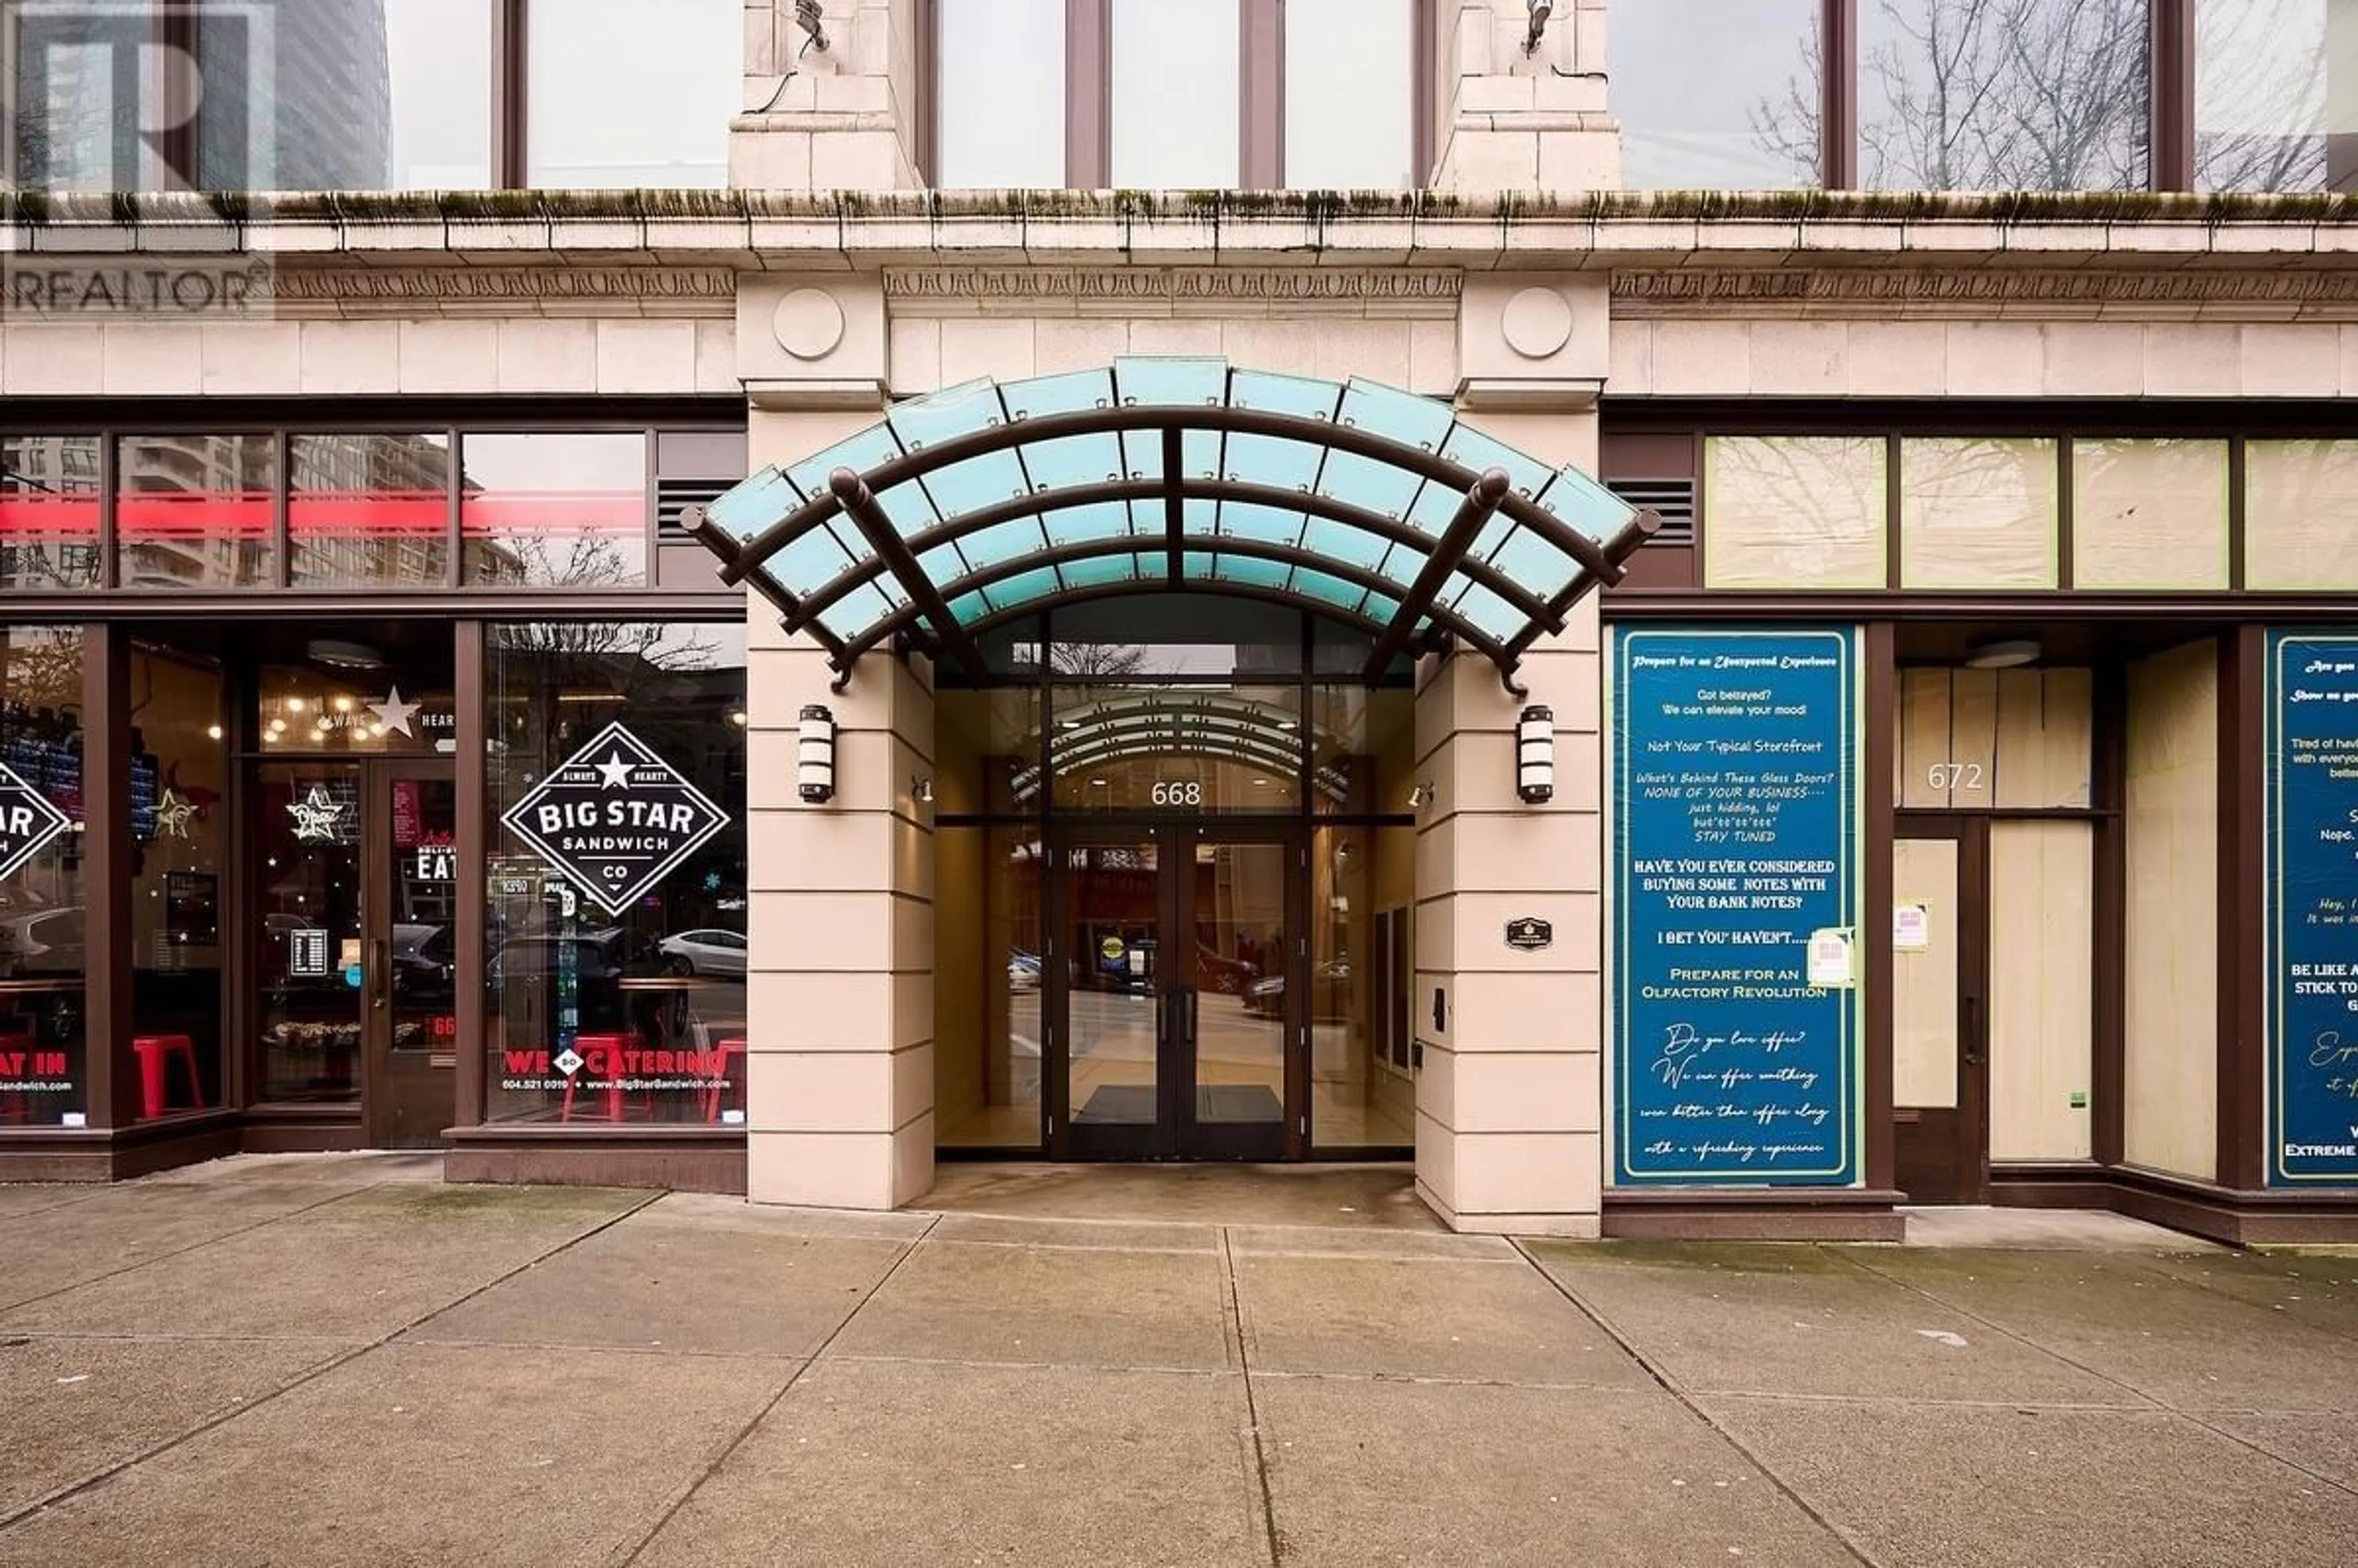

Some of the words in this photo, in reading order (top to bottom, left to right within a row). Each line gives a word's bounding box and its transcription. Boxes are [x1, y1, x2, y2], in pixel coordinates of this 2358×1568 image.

[1680, 656, 1696, 667] for
[1697, 689, 1718, 701] Got
[1720, 689, 1772, 703] betrayed?
[1662, 705, 1679, 715] We
[1683, 707, 1703, 715] can
[1706, 705, 1744, 715] elevate
[1747, 707, 1771, 718] your
[1648, 740, 1672, 752] Not
[1675, 740, 1702, 752] Your
[1706, 740, 1751, 755] Typical
[1754, 739, 1824, 753] Storefront
[2291, 739, 2319, 749] Tired
[563, 772, 596, 781] ALWAYS
[634, 772, 667, 781] HEARTY
[1636, 772, 1675, 783] What's
[1679, 772, 1718, 783] Behind
[1724, 772, 1756, 783] These
[1761, 772, 1789, 783] Glass
[1794, 772, 1835, 784] Doors?
[1929, 764, 1982, 789] 672
[1151, 782, 1200, 805] 668
[1644, 787, 1682, 798] NONE
[1686, 787, 1703, 798] OF
[1708, 787, 1743, 798] YOUR
[1688, 802, 1712, 815] just
[1718, 802, 1759, 815] kidding,
[1765, 801, 1781, 813] lol
[538, 801, 597, 834] BIG
[607, 801, 695, 834] STAR
[1694, 831, 1729, 844] STAY
[1734, 831, 1776, 843] TUNED
[2320, 829, 2356, 843] Nope.
[562, 837, 669, 850] SANDWICH
[602, 866, 628, 878] CO
[1634, 860, 1675, 873] HAVE
[1677, 860, 1705, 873] YOU
[1708, 860, 1746, 873] EVER
[1749, 860, 1835, 873] CONSIDERED
[1643, 877, 1695, 891] BUYING
[1698, 878, 1737, 891] SOME
[1744, 878, 1789, 891] NOTES
[1792, 877, 1826, 891] WITH
[1667, 896, 1705, 909] YOUR
[1708, 896, 1748, 909] BANK
[1752, 896, 1804, 909] NOTES?
[1658, 932, 1663, 944] I
[1665, 932, 1695, 944] BET
[2291, 964, 2312, 976] BE
[2314, 964, 2348, 976] LIKE
[2295, 982, 2337, 994] STICK
[2338, 982, 2357, 994] TO
[1663, 1023, 1700, 1056] Do
[1700, 1036, 1727, 1053] you
[1730, 1030, 1756, 1045] love
[1760, 1031, 1807, 1052] coffee?
[37, 1053, 66, 1074] IN
[504, 1051, 549, 1073] WE
[586, 1051, 726, 1074] CATERING
[1650, 1054, 1698, 1090] We
[1695, 1071, 1718, 1080] can
[1720, 1068, 1754, 1089] offer
[1758, 1068, 1819, 1089] something
[1640, 1109, 1667, 1117] even
[1671, 1104, 1713, 1119] better
[1716, 1103, 1748, 1117] than
[1753, 1104, 1791, 1125] coffee
[1794, 1103, 1831, 1125] along
[1644, 1140, 1675, 1154] with
[1691, 1140, 1757, 1162] refreshing
[1762, 1143, 1825, 1161] experience
